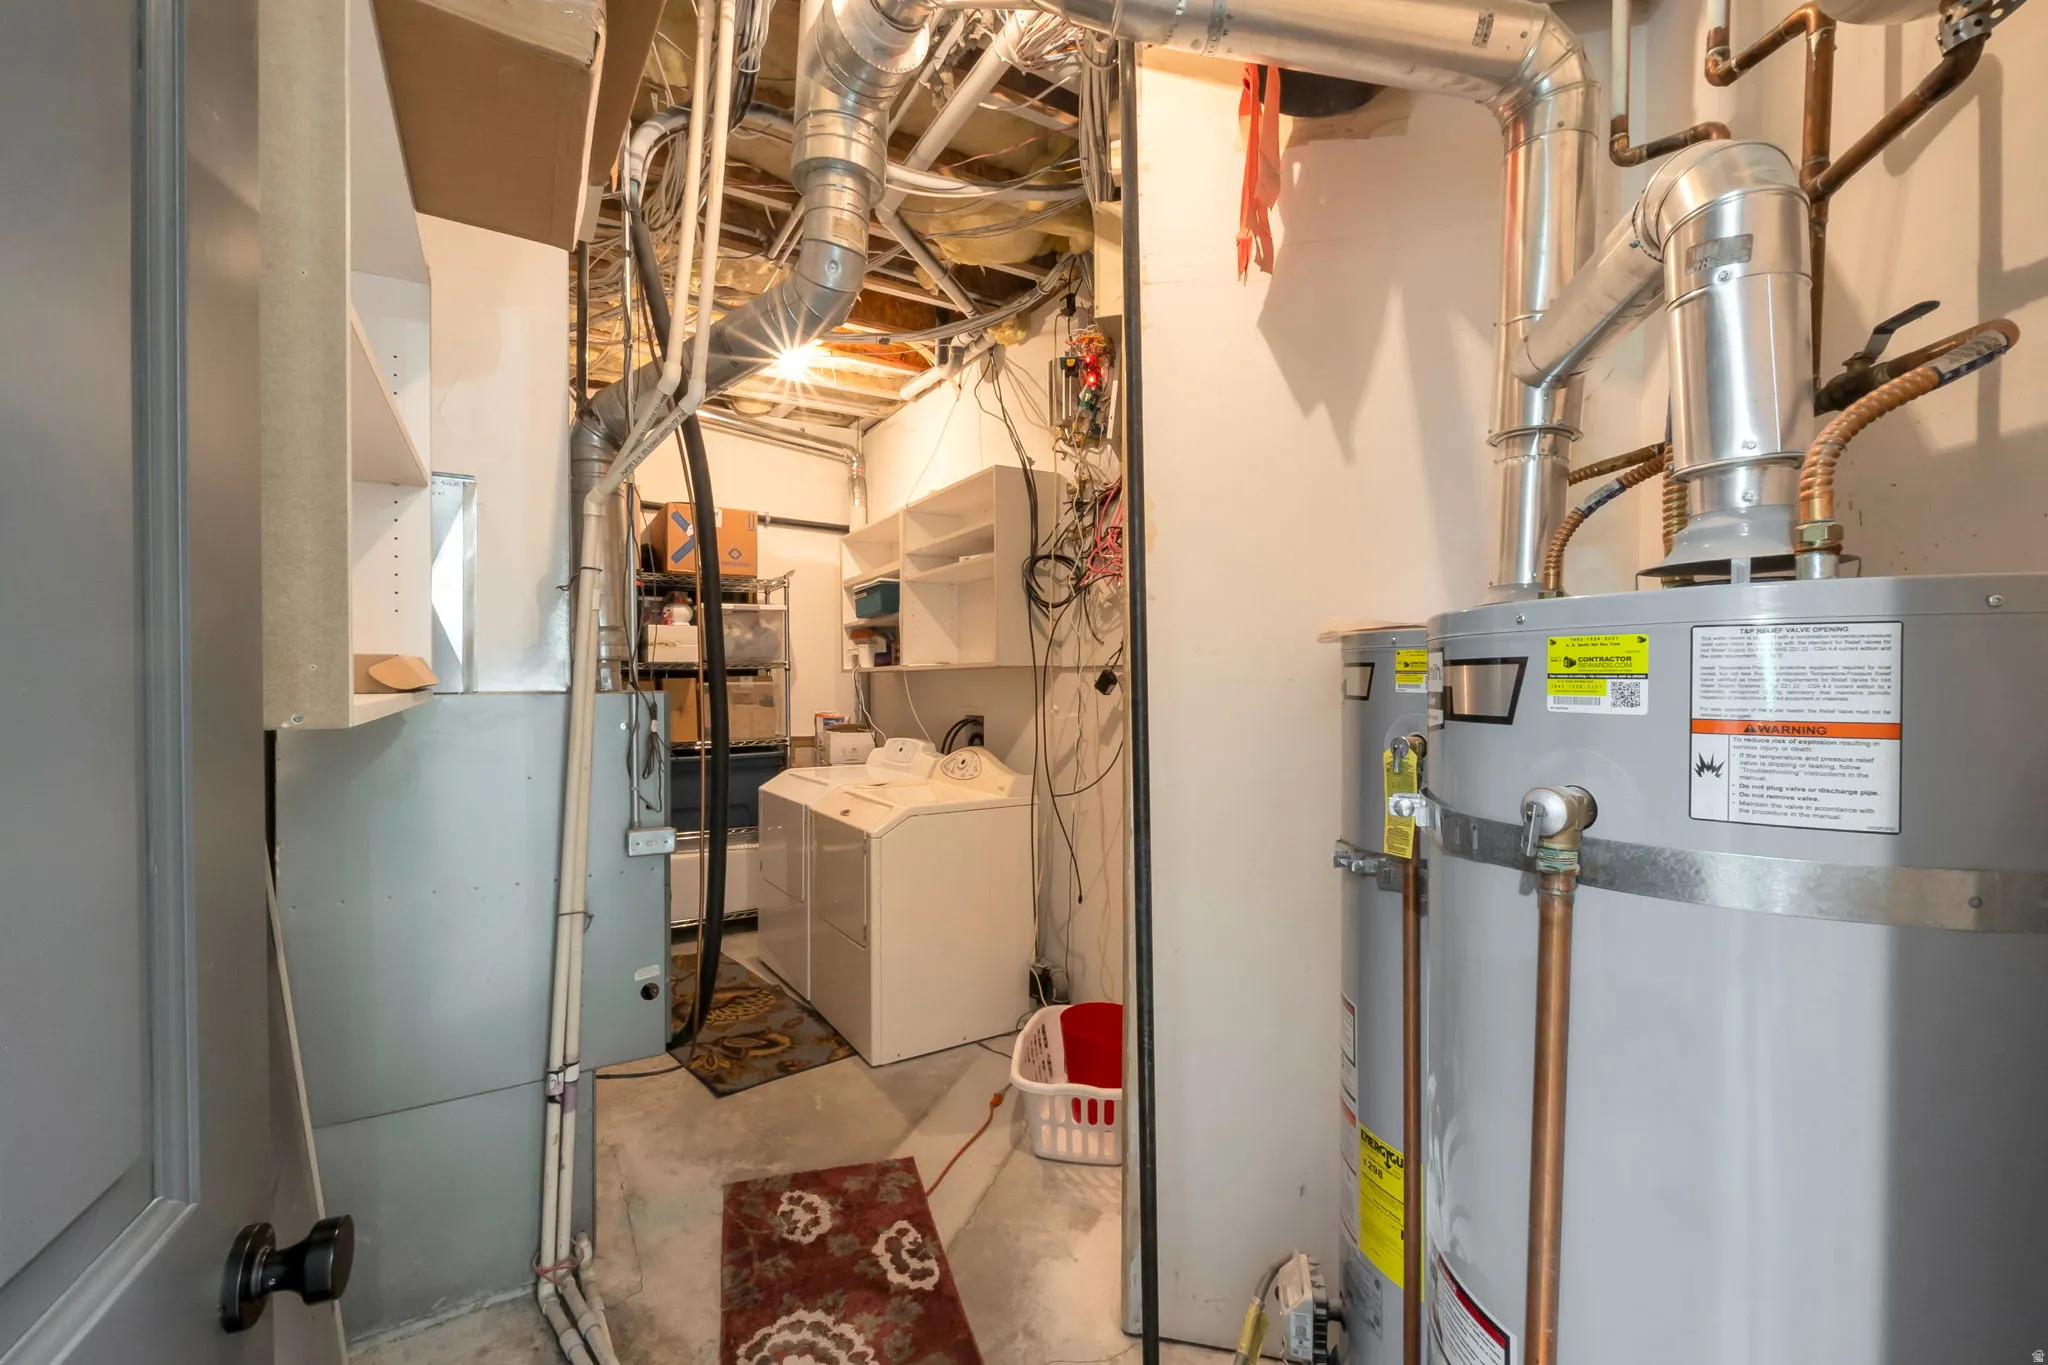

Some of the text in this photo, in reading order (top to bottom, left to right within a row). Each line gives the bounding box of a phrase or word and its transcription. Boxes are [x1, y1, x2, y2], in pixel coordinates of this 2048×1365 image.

[1758, 724, 1828, 736] WARNING
[1798, 739, 1837, 747] explosion
[1839, 740, 1871, 748] resulting
[1767, 761, 1797, 769] dripping
[1804, 770, 1846, 778] instructions
[1818, 788, 1858, 796] discharge
[1751, 809, 1789, 817] procedure
[1814, 806, 1858, 814] accordance
[1360, 1128, 1404, 1169] ENERGYGU
